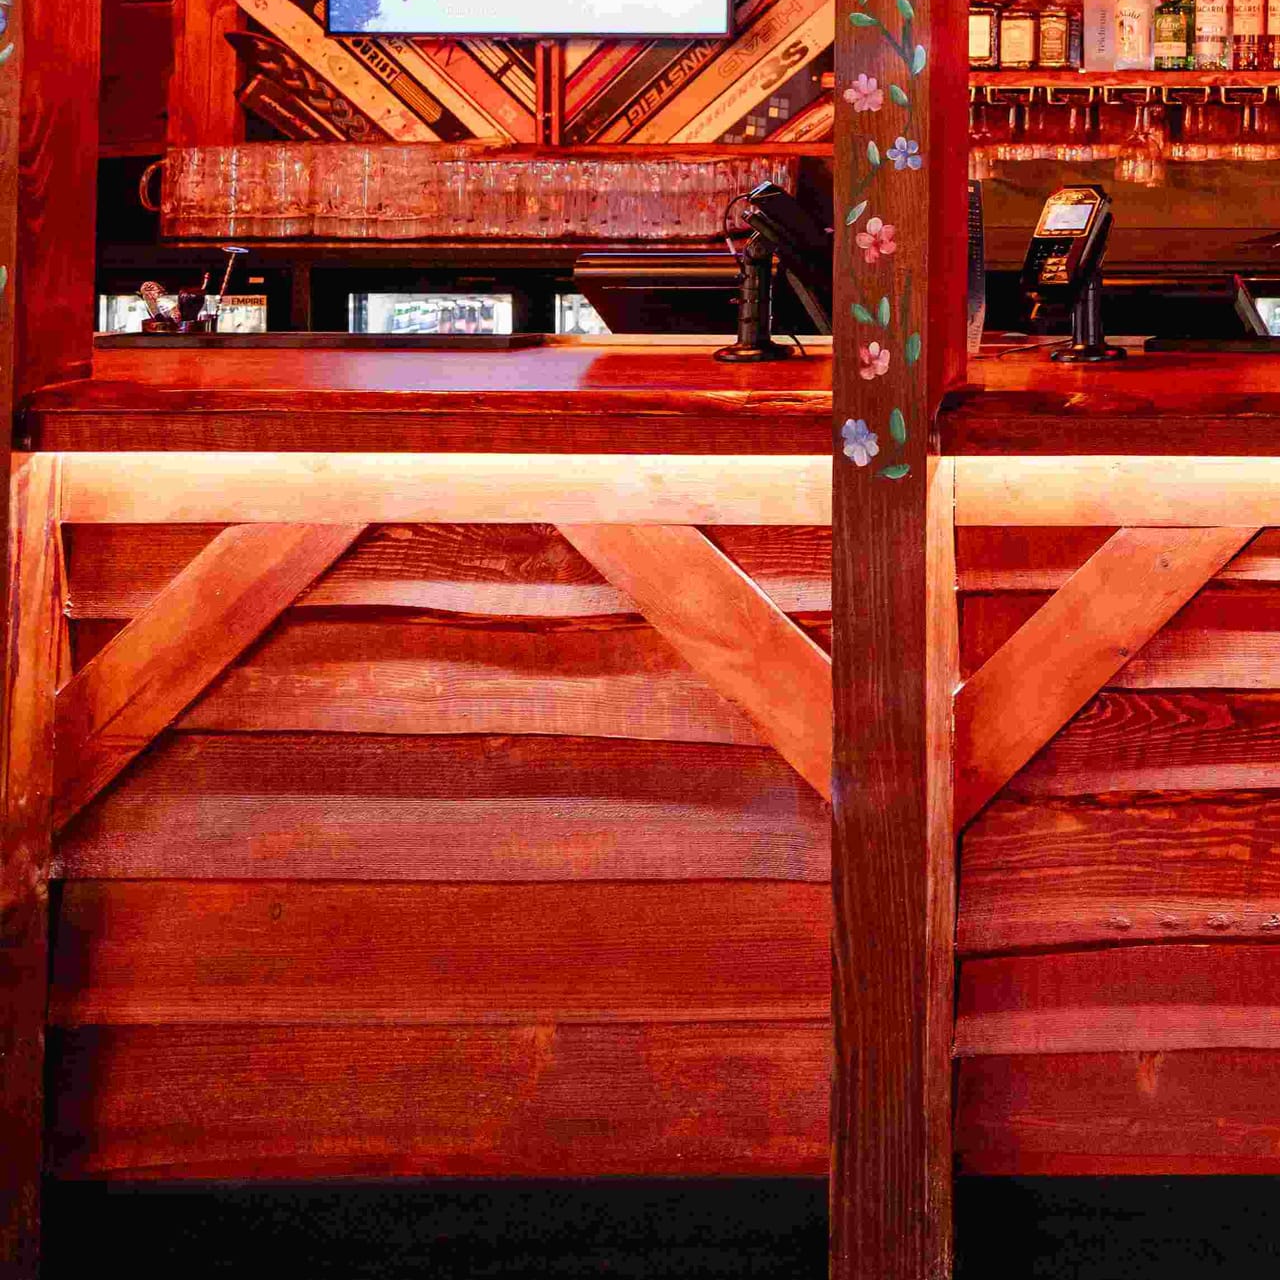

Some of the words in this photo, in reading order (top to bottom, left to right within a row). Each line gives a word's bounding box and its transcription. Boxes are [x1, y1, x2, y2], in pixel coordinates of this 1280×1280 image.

[352, 37, 398, 80] OURIST
[628, 40, 716, 128] NNSTEIG
[231, 297, 265, 306] EMPIRE
